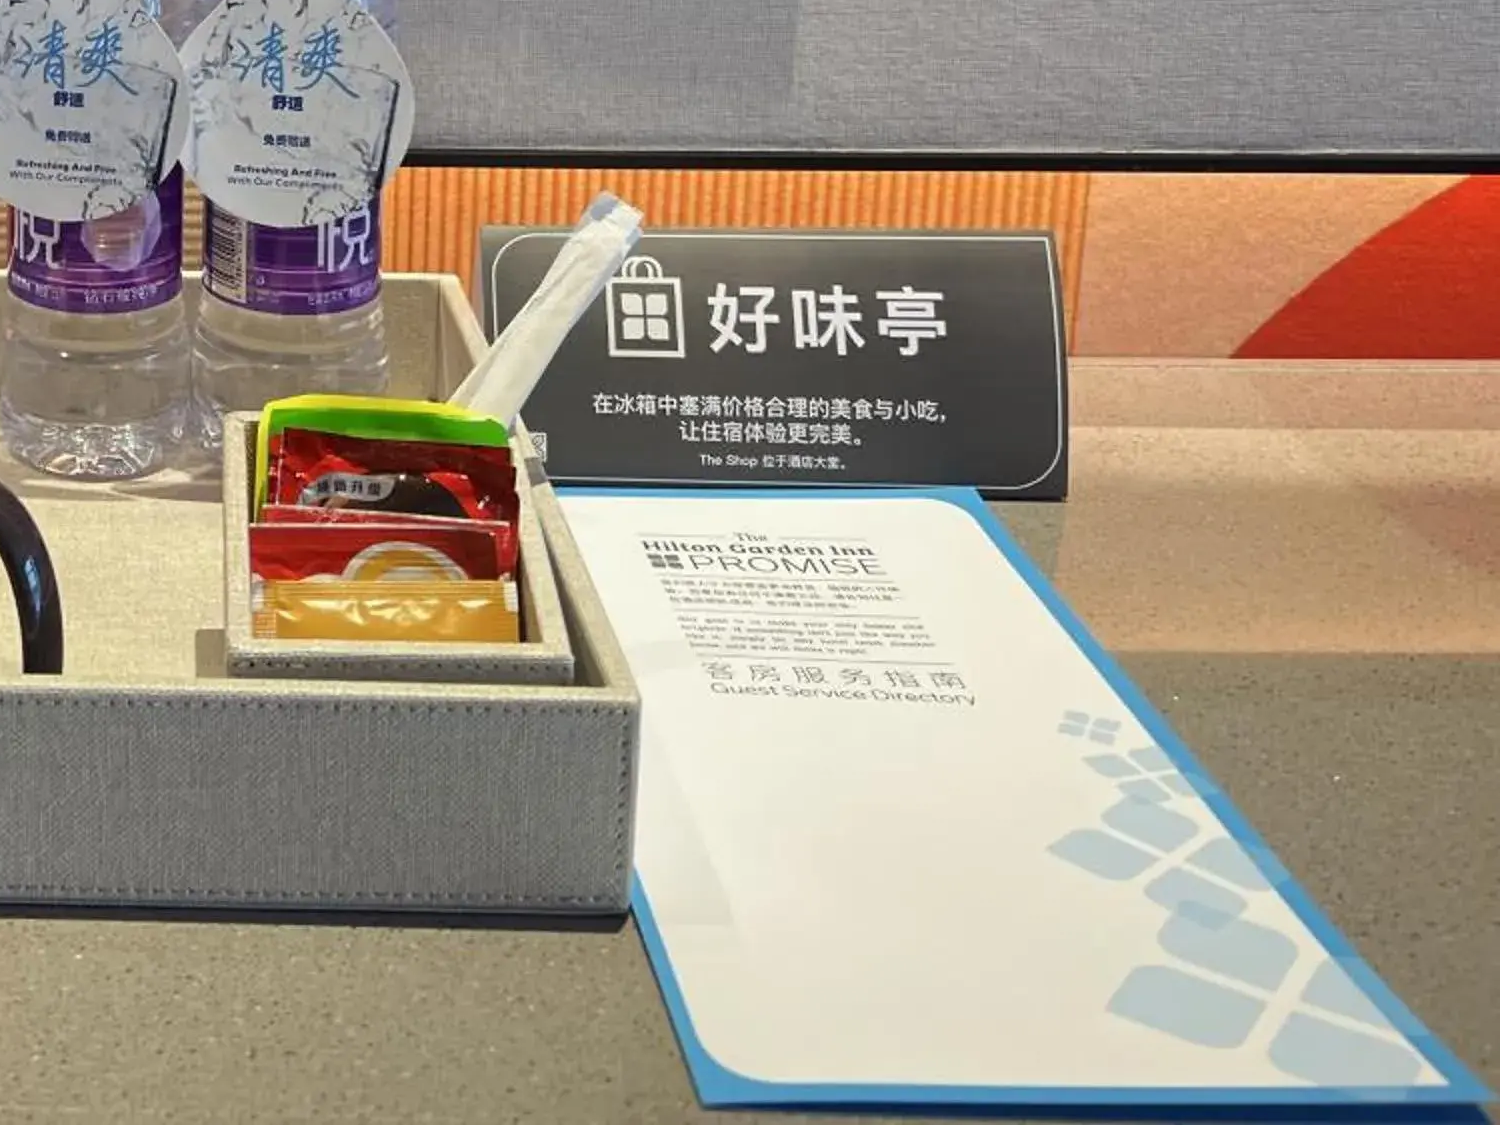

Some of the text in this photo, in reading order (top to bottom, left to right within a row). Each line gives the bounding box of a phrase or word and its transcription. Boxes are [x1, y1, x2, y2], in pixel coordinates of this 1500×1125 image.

[13, 16, 139, 95] 清爽
[231, 18, 360, 99] 清爽
[35, 171, 54, 181] Our
[71, 162, 92, 172] And
[233, 164, 289, 177] Refreshing
[291, 167, 313, 177] And
[253, 176, 273, 187] Our
[707, 282, 947, 356] 好味亭
[679, 420, 862, 446] 让住宿体验更完美。
[700, 454, 722, 466] The
[725, 454, 758, 468] Shop
[642, 539, 875, 556] Hilton Garden Inn
[688, 554, 888, 576] PROMISE
[702, 661, 967, 689] 客房服务指南
[783, 684, 867, 701] Service
[872, 688, 976, 707] Directory
